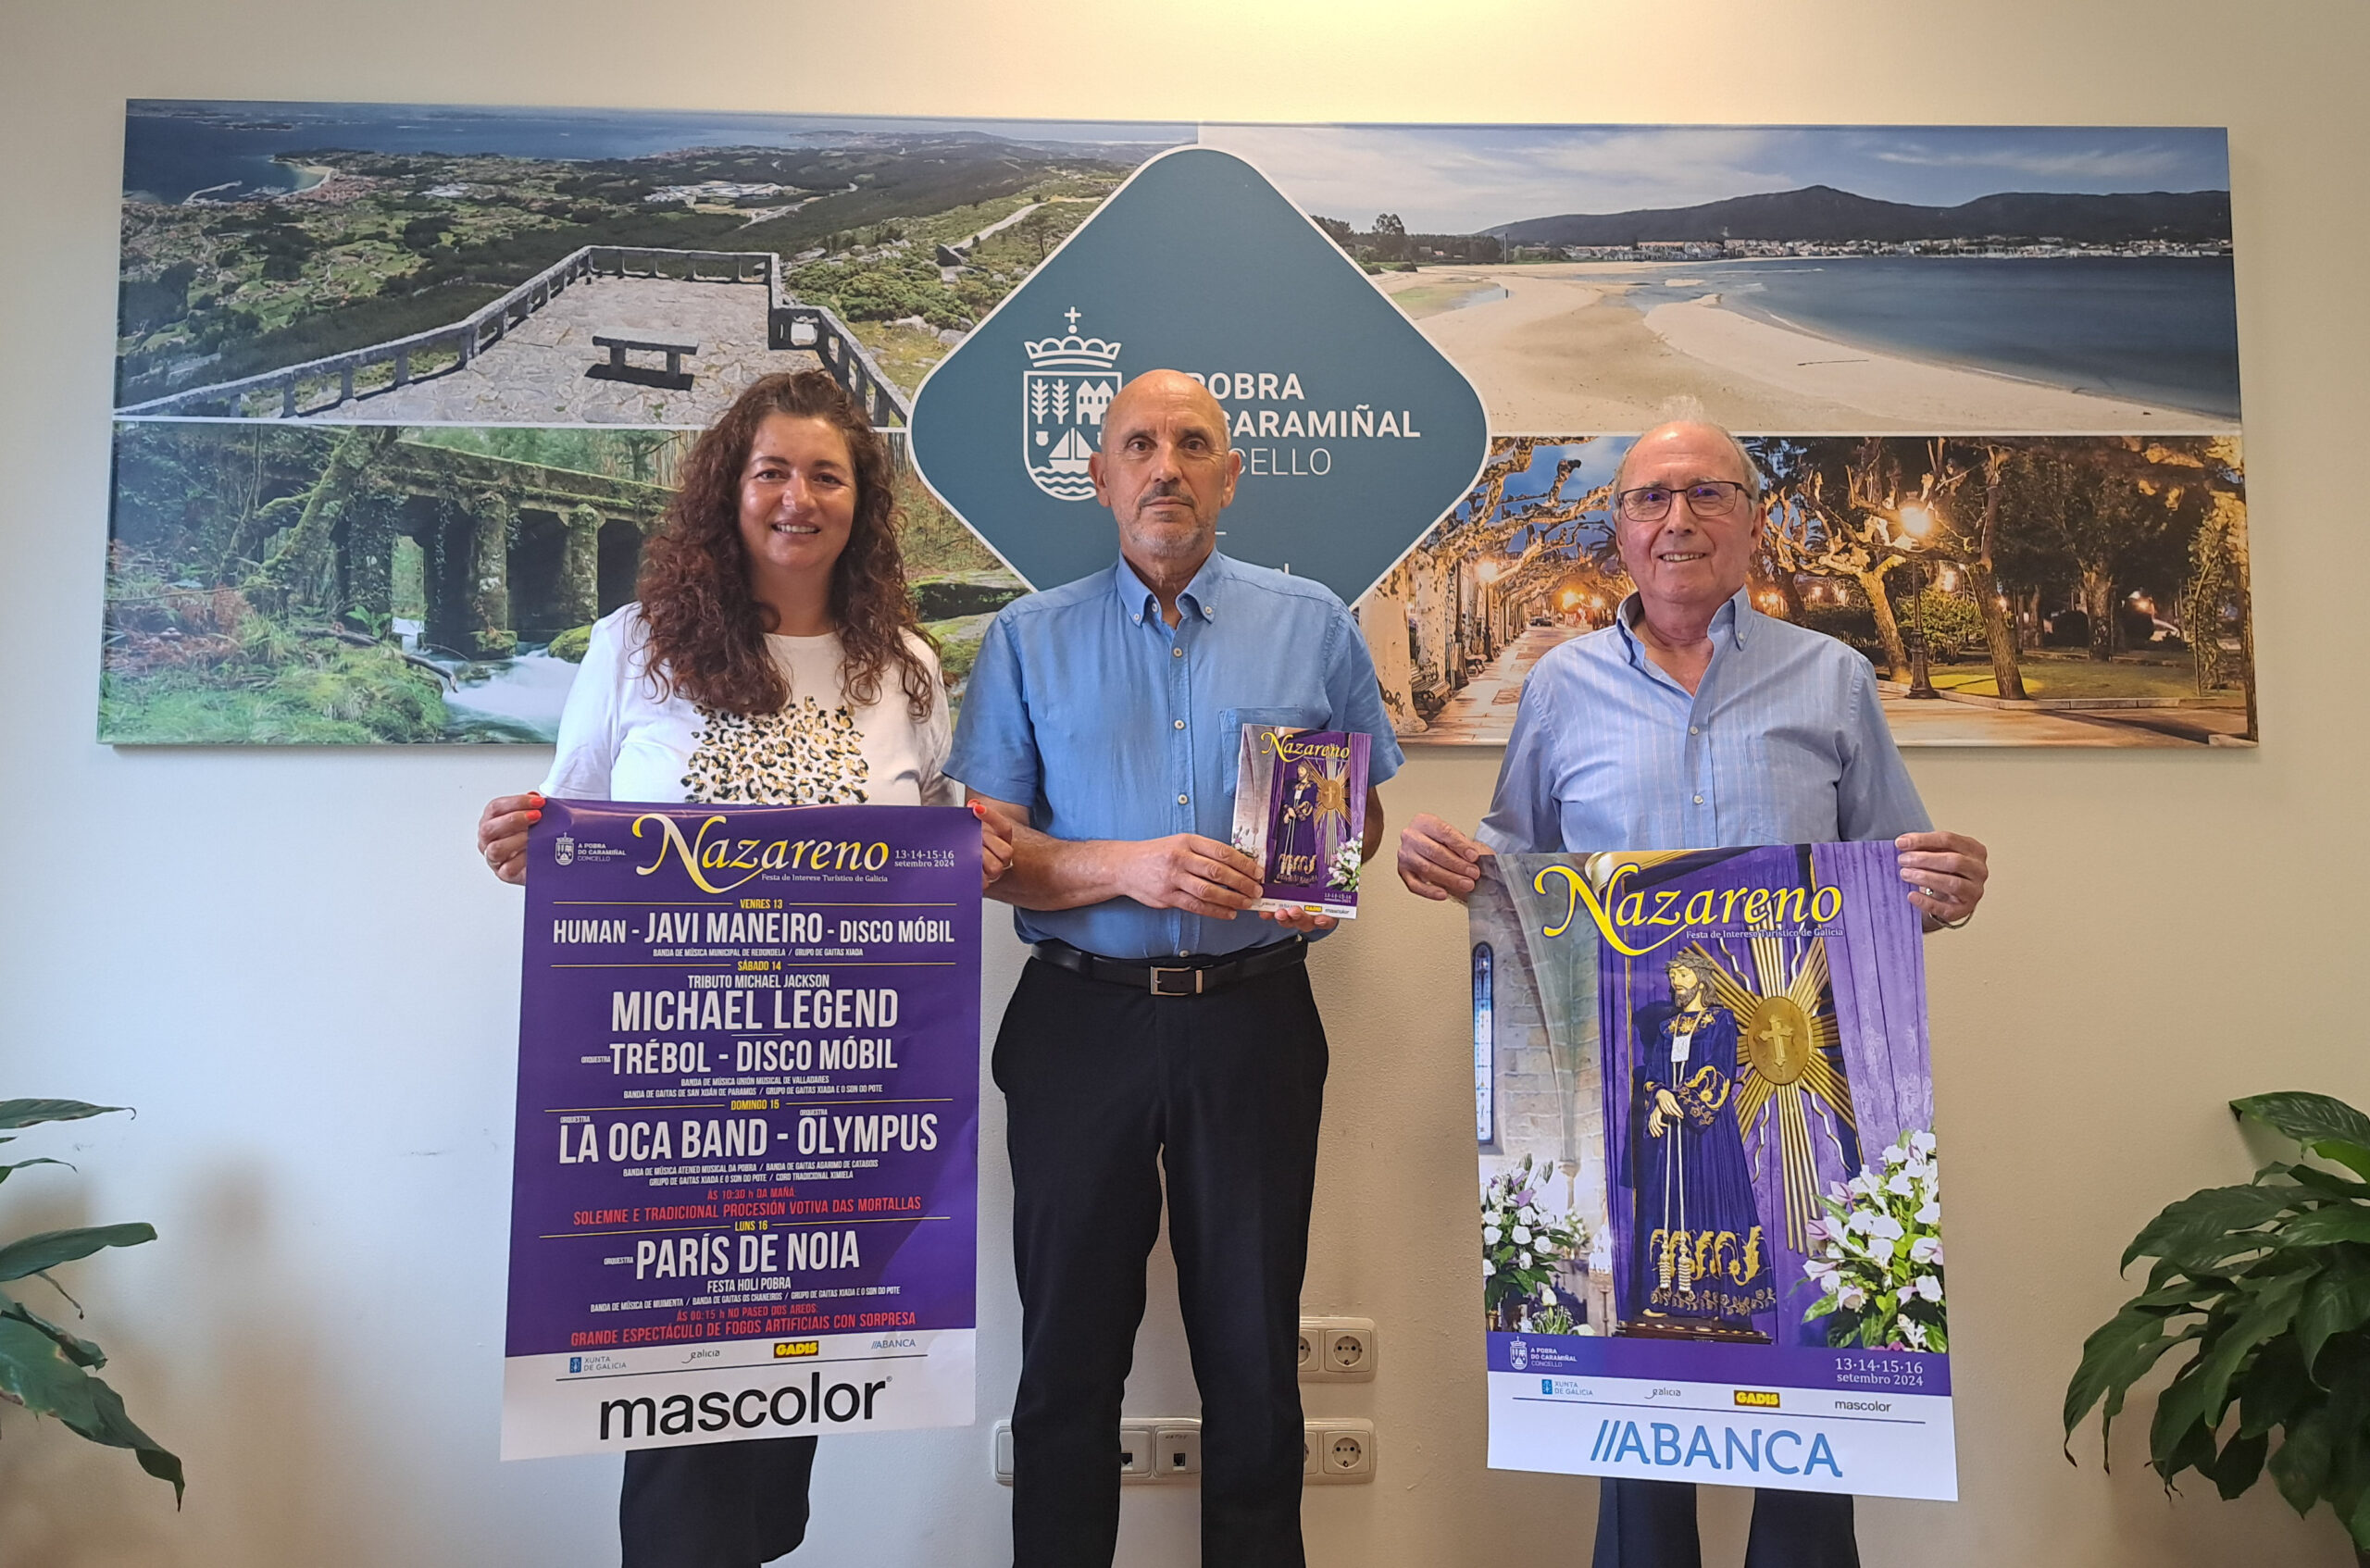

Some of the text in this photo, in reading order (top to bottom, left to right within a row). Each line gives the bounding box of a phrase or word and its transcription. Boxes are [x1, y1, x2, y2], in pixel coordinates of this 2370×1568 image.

[1261, 732, 1350, 762] Nazareno
[631, 813, 890, 894] Nazareno
[741, 899, 782, 909] VENRES 13
[1533, 864, 1842, 956] Nazareno
[554, 920, 626, 943] HUMAN
[644, 913, 699, 943] JAVI
[706, 913, 823, 943] MANEIRO
[840, 920, 893, 942] DISCO
[898, 915, 954, 942] MÓBIL
[1814, 928, 1843, 937] Galicia
[737, 960, 781, 971] SÁBADO 14
[688, 975, 830, 989] TRIBUTO MICHAEL JACKSON
[611, 989, 898, 1031] MICHAEL LEGEND
[609, 1039, 711, 1074] TRÉBOL
[737, 1040, 812, 1072] DISCO
[819, 1036, 898, 1070] MÓBIL
[731, 1099, 780, 1111] DOMINGO 15
[559, 1124, 599, 1164] LA
[609, 1122, 672, 1162] OCA
[681, 1118, 767, 1159] BAND
[798, 1114, 938, 1155] OLYMPUS
[722, 1189, 745, 1200] 10:30
[756, 1188, 767, 1199] DA
[573, 1197, 921, 1226] SOLEMNE E TRADICIONAL PROCESIÓN VOTIVA DAS MORTALLAS
[735, 1221, 767, 1231] LUNS 16
[636, 1230, 860, 1280] PARÍS DE NOIA
[707, 1276, 791, 1293] FESTA HOLI POBRA
[690, 1310, 716, 1321] 00:15
[728, 1308, 739, 1318] NO
[742, 1305, 767, 1316] PASEO
[771, 1304, 786, 1314] DOS
[571, 1312, 917, 1347] GRANDE ESPECTÁCULO DE FOGOS ARTIFICIAIS CON SORPRESA
[776, 1343, 817, 1355] GADIS
[596, 1363, 626, 1371] GALICIA
[1837, 1374, 1923, 1386] setembro 2024
[1644, 1388, 1681, 1399] galicia
[1736, 1392, 1778, 1406] GADIS
[1835, 1400, 1891, 1412] mascolor
